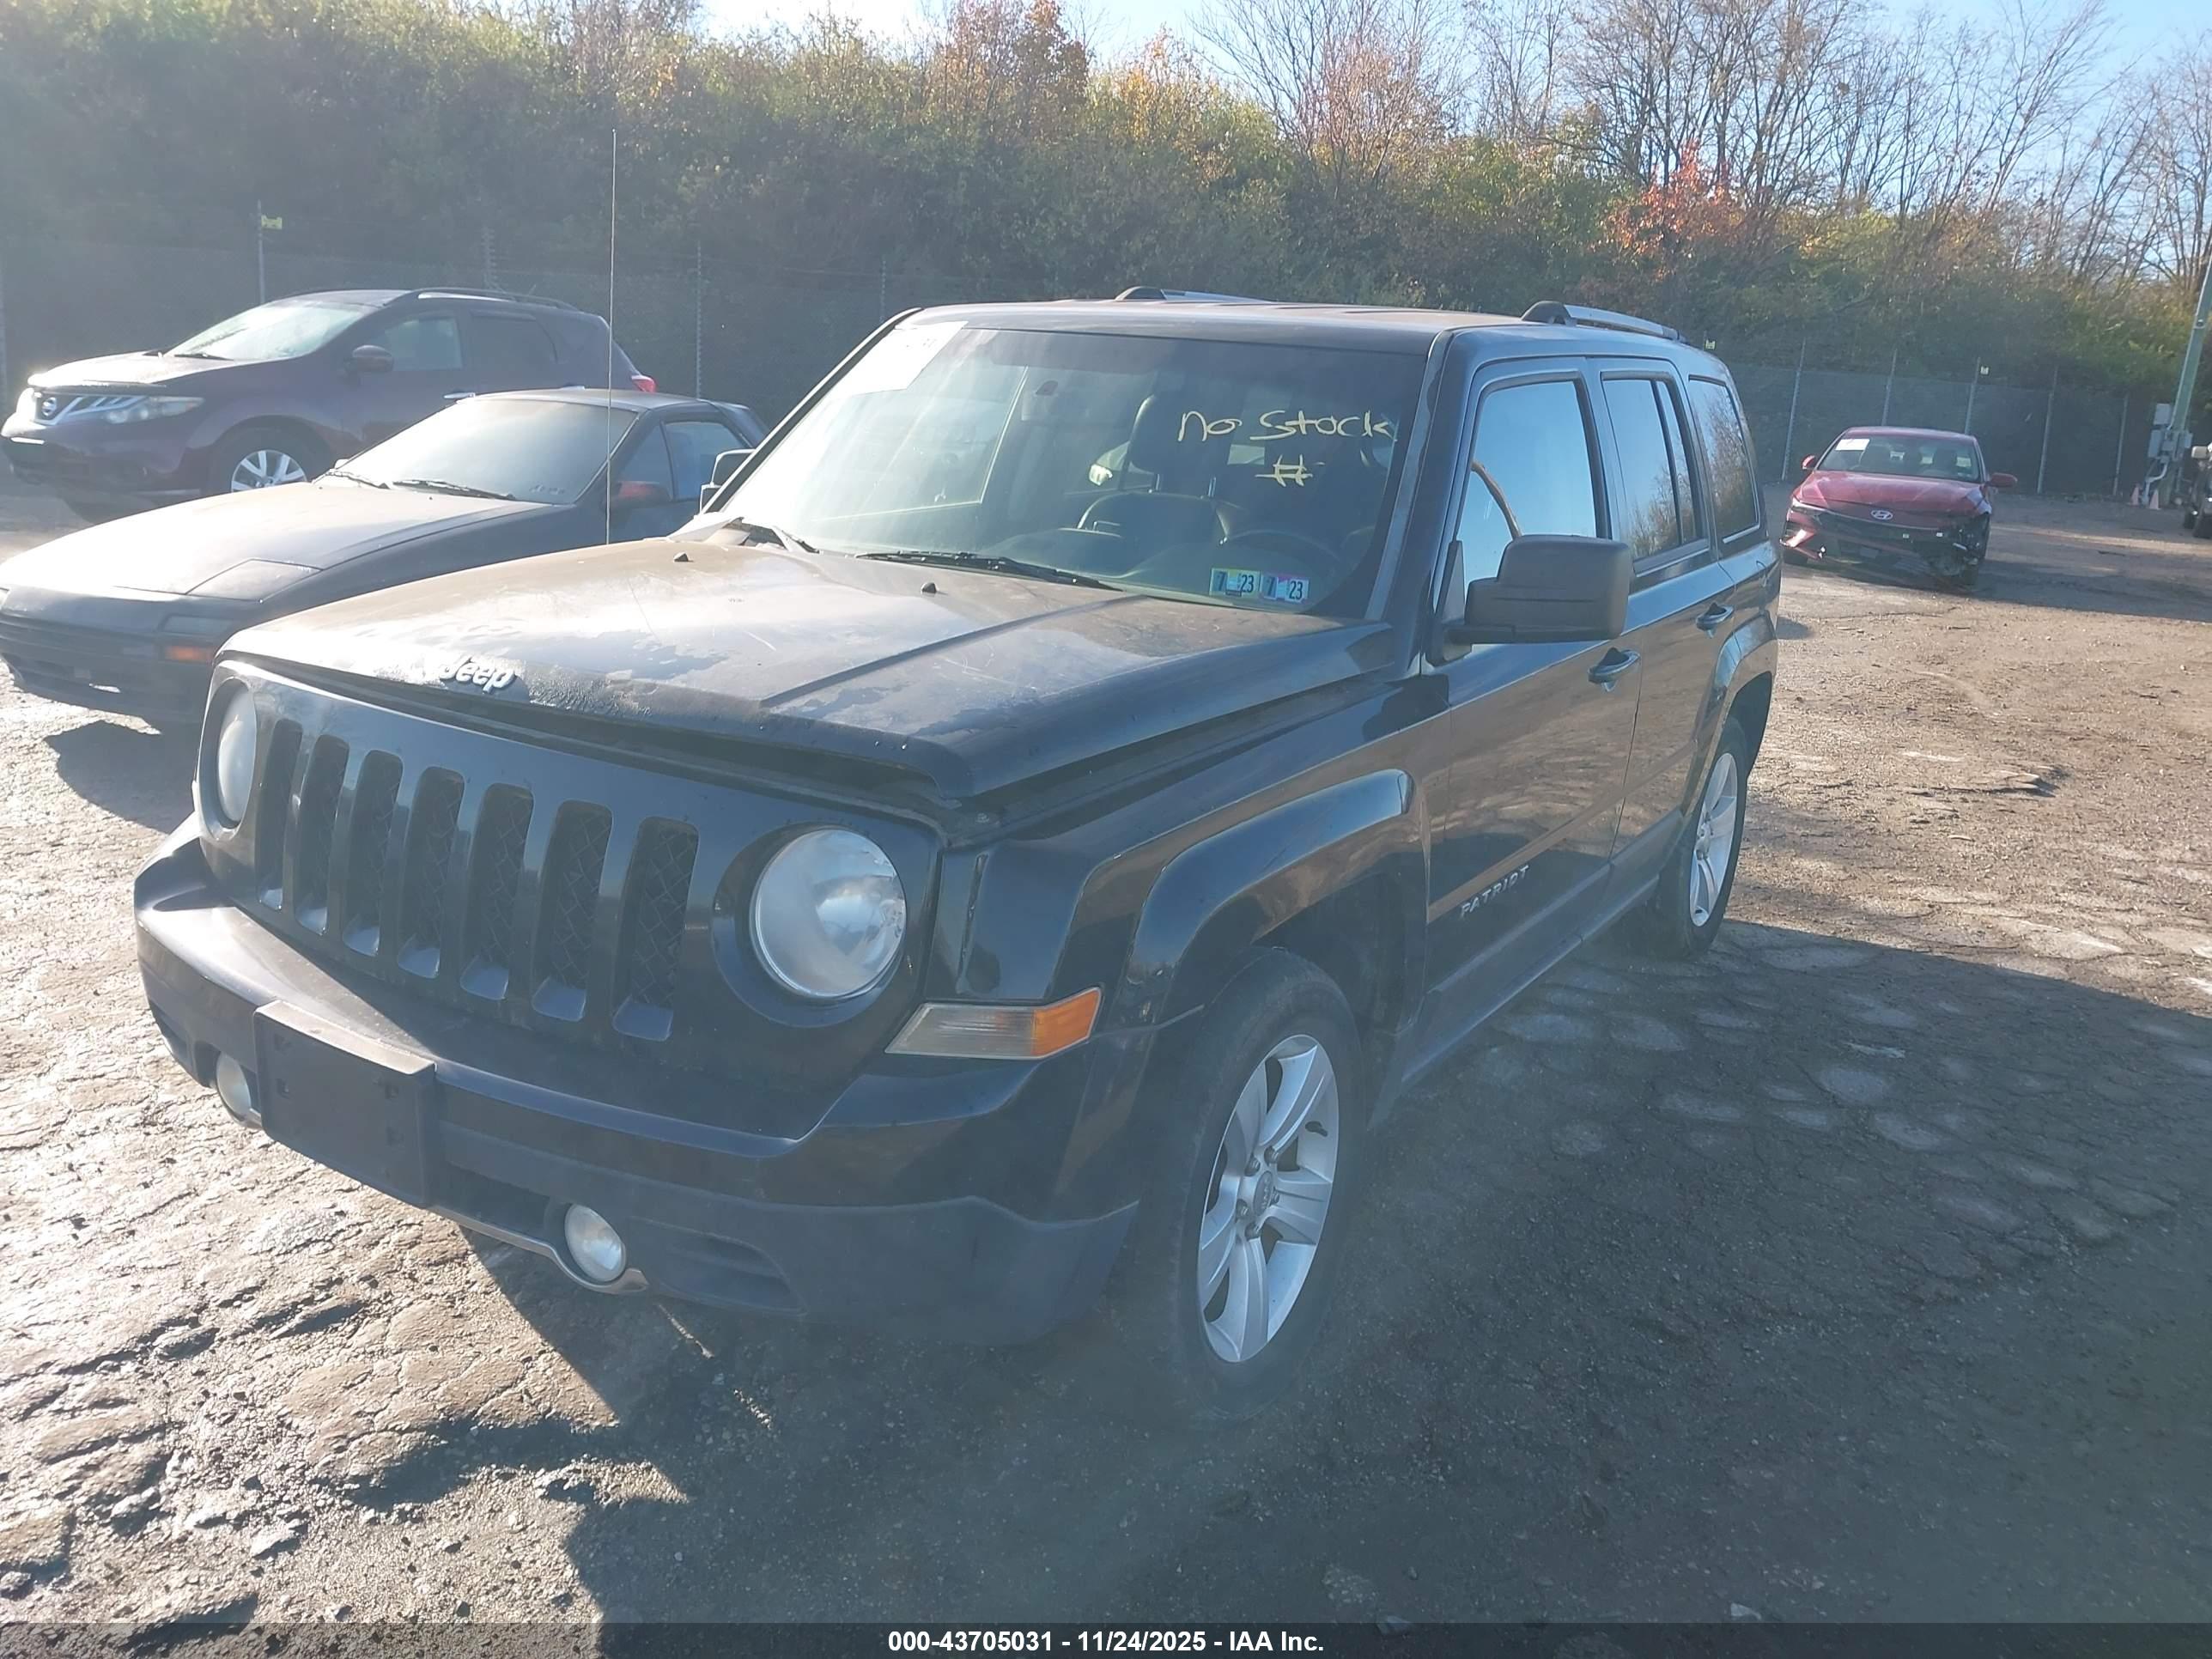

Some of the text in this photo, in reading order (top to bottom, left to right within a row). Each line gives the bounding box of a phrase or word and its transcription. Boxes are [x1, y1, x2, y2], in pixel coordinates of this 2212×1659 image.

[1250, 410, 1397, 441] Stock
[1255, 454, 1313, 487] #
[1241, 574, 1255, 592] 23
[1289, 580, 1304, 600] 23
[439, 655, 516, 694] Jeep
[1461, 864, 1529, 918] PATRIOT
